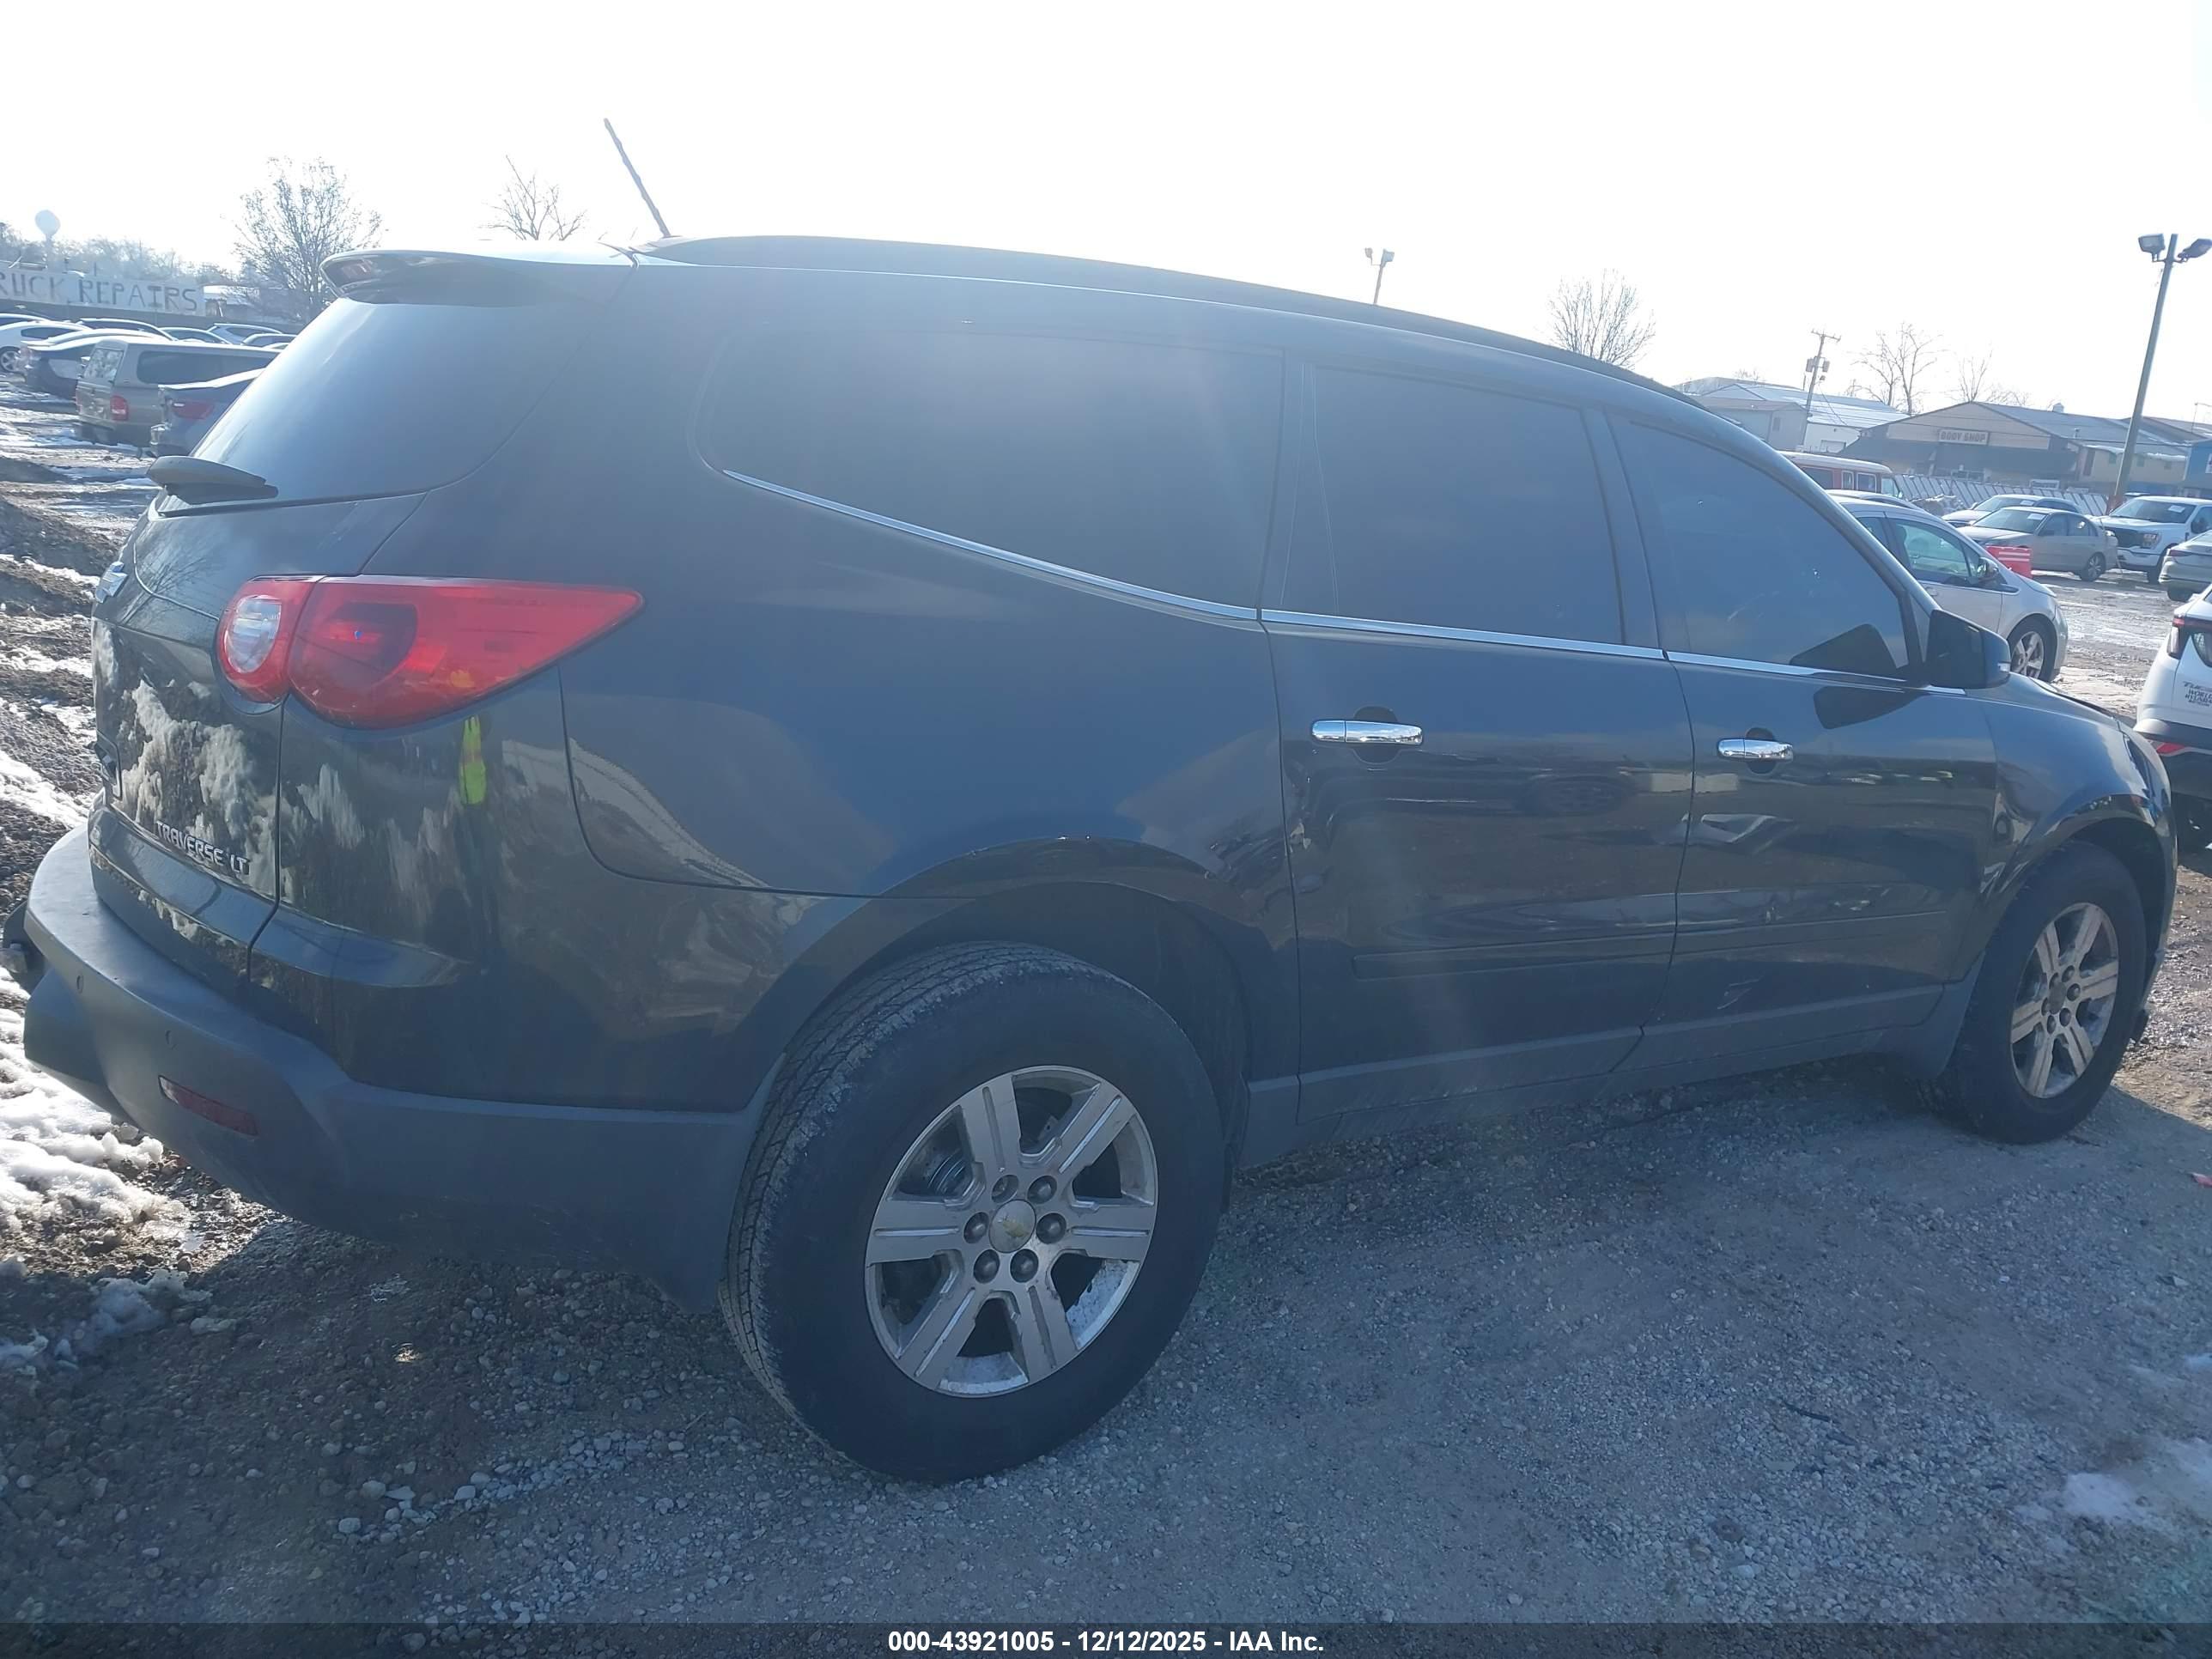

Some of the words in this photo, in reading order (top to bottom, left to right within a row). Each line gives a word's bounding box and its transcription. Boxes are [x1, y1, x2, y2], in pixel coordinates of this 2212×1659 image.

[78, 278, 198, 312] REPAIRS
[1940, 431, 1963, 441] BODY
[156, 820, 224, 866] TRAVERSE
[229, 854, 247, 874] LT
